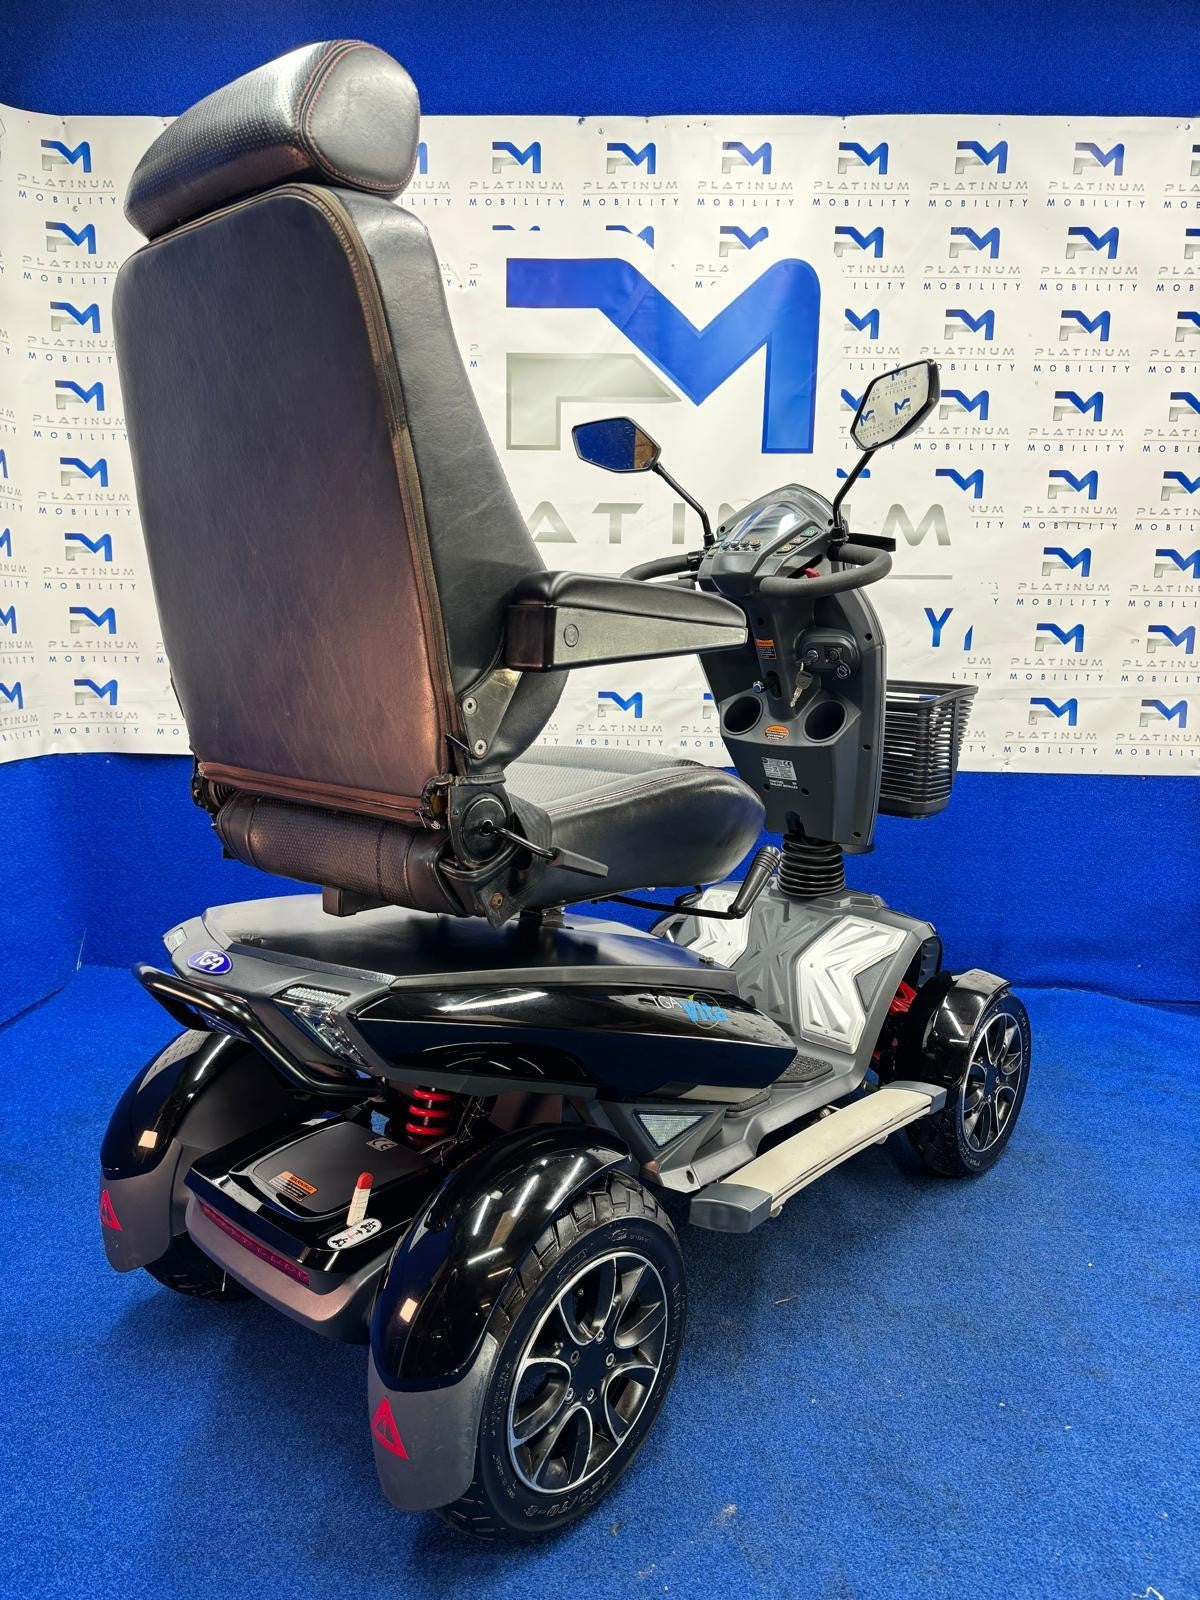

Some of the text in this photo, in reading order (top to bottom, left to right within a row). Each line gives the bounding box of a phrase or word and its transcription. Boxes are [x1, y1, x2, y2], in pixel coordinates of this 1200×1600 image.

[17, 173, 115, 189] PLATINUM
[469, 181, 564, 190] PLATINUM
[583, 181, 678, 190] PLATINUM
[698, 181, 793, 191] PLATINUM
[813, 181, 909, 191] PLATINUM
[929, 181, 1028, 191] PLATINUM
[1049, 181, 1145, 192] PLATINUM
[18, 190, 116, 205] MOBILITY
[469, 198, 565, 207] MOBILITY
[583, 198, 679, 207] MOBILITY
[697, 198, 794, 207] MOBILITY
[812, 198, 910, 207] MOBILITY
[928, 199, 1028, 208] MOBILITY
[1047, 198, 1145, 208] MOBILITY
[22, 255, 118, 270] PLATINUM
[848, 265, 905, 273] TINUM
[924, 265, 1021, 275] PLATINUM
[1040, 266, 1138, 275] PLATINUM
[1158, 267, 1200, 275] PLAT
[23, 272, 107, 285] MOBILIT
[853, 281, 905, 290] ILITY
[923, 282, 1021, 291] MOBILITY
[1039, 283, 1138, 292] MOBILITY
[27, 336, 114, 348] PLATINU
[844, 346, 901, 355] TINUM
[920, 347, 1015, 356] PLATINUM
[1034, 348, 1130, 357] PLATINUM
[1150, 349, 1198, 358] PLAT
[28, 352, 113, 364] MOBILIT
[849, 363, 901, 371] ILITY
[1033, 365, 1131, 374] MOBILITY
[1148, 366, 1197, 374] MOBI
[32, 414, 125, 426] PLATINUM
[33, 430, 128, 441] MOBILITY
[915, 427, 1010, 436] PLATINUM
[1028, 428, 1124, 437] PLATINUM
[1144, 429, 1200, 437] PLATI
[913, 443, 1010, 451] MOBILITY
[1027, 444, 1125, 452] MOBILITY
[37, 491, 130, 502] PLATINUM
[38, 506, 132, 516] MOBILITY
[1023, 506, 1118, 515] PLATINUM
[1136, 508, 1200, 516] PLATIN
[1022, 521, 1118, 531] MOBILITY
[1134, 523, 1195, 532] MOBIL
[43, 566, 135, 576] PLATINUM
[4, 581, 29, 589] LITY
[44, 581, 137, 591] MOBILITY
[1018, 583, 1110, 592] PLATINUM
[1016, 598, 1111, 607] MOBILITY
[1128, 600, 1197, 608] MOBILI
[0, 641, 33, 649] TINUM
[48, 640, 139, 649] PLATINUM
[3, 657, 35, 665] ILITY
[49, 654, 140, 664] MOBILITY
[1010, 658, 1103, 667] PLATINUM
[1122, 659, 1200, 668] PLATINU
[952, 672, 992, 680] LITY
[1009, 673, 1104, 682] MOBILITY
[53, 711, 138, 720] PLATINUM
[53, 727, 139, 736] MOBILITY
[576, 723, 663, 733] PLATINUM
[680, 725, 720, 734] PLAT
[1004, 731, 1097, 740] PLATINUM
[575, 738, 664, 747] MOBILITY
[1003, 746, 1097, 754] MOBILITY
[1114, 748, 1195, 757] MOBILIT
